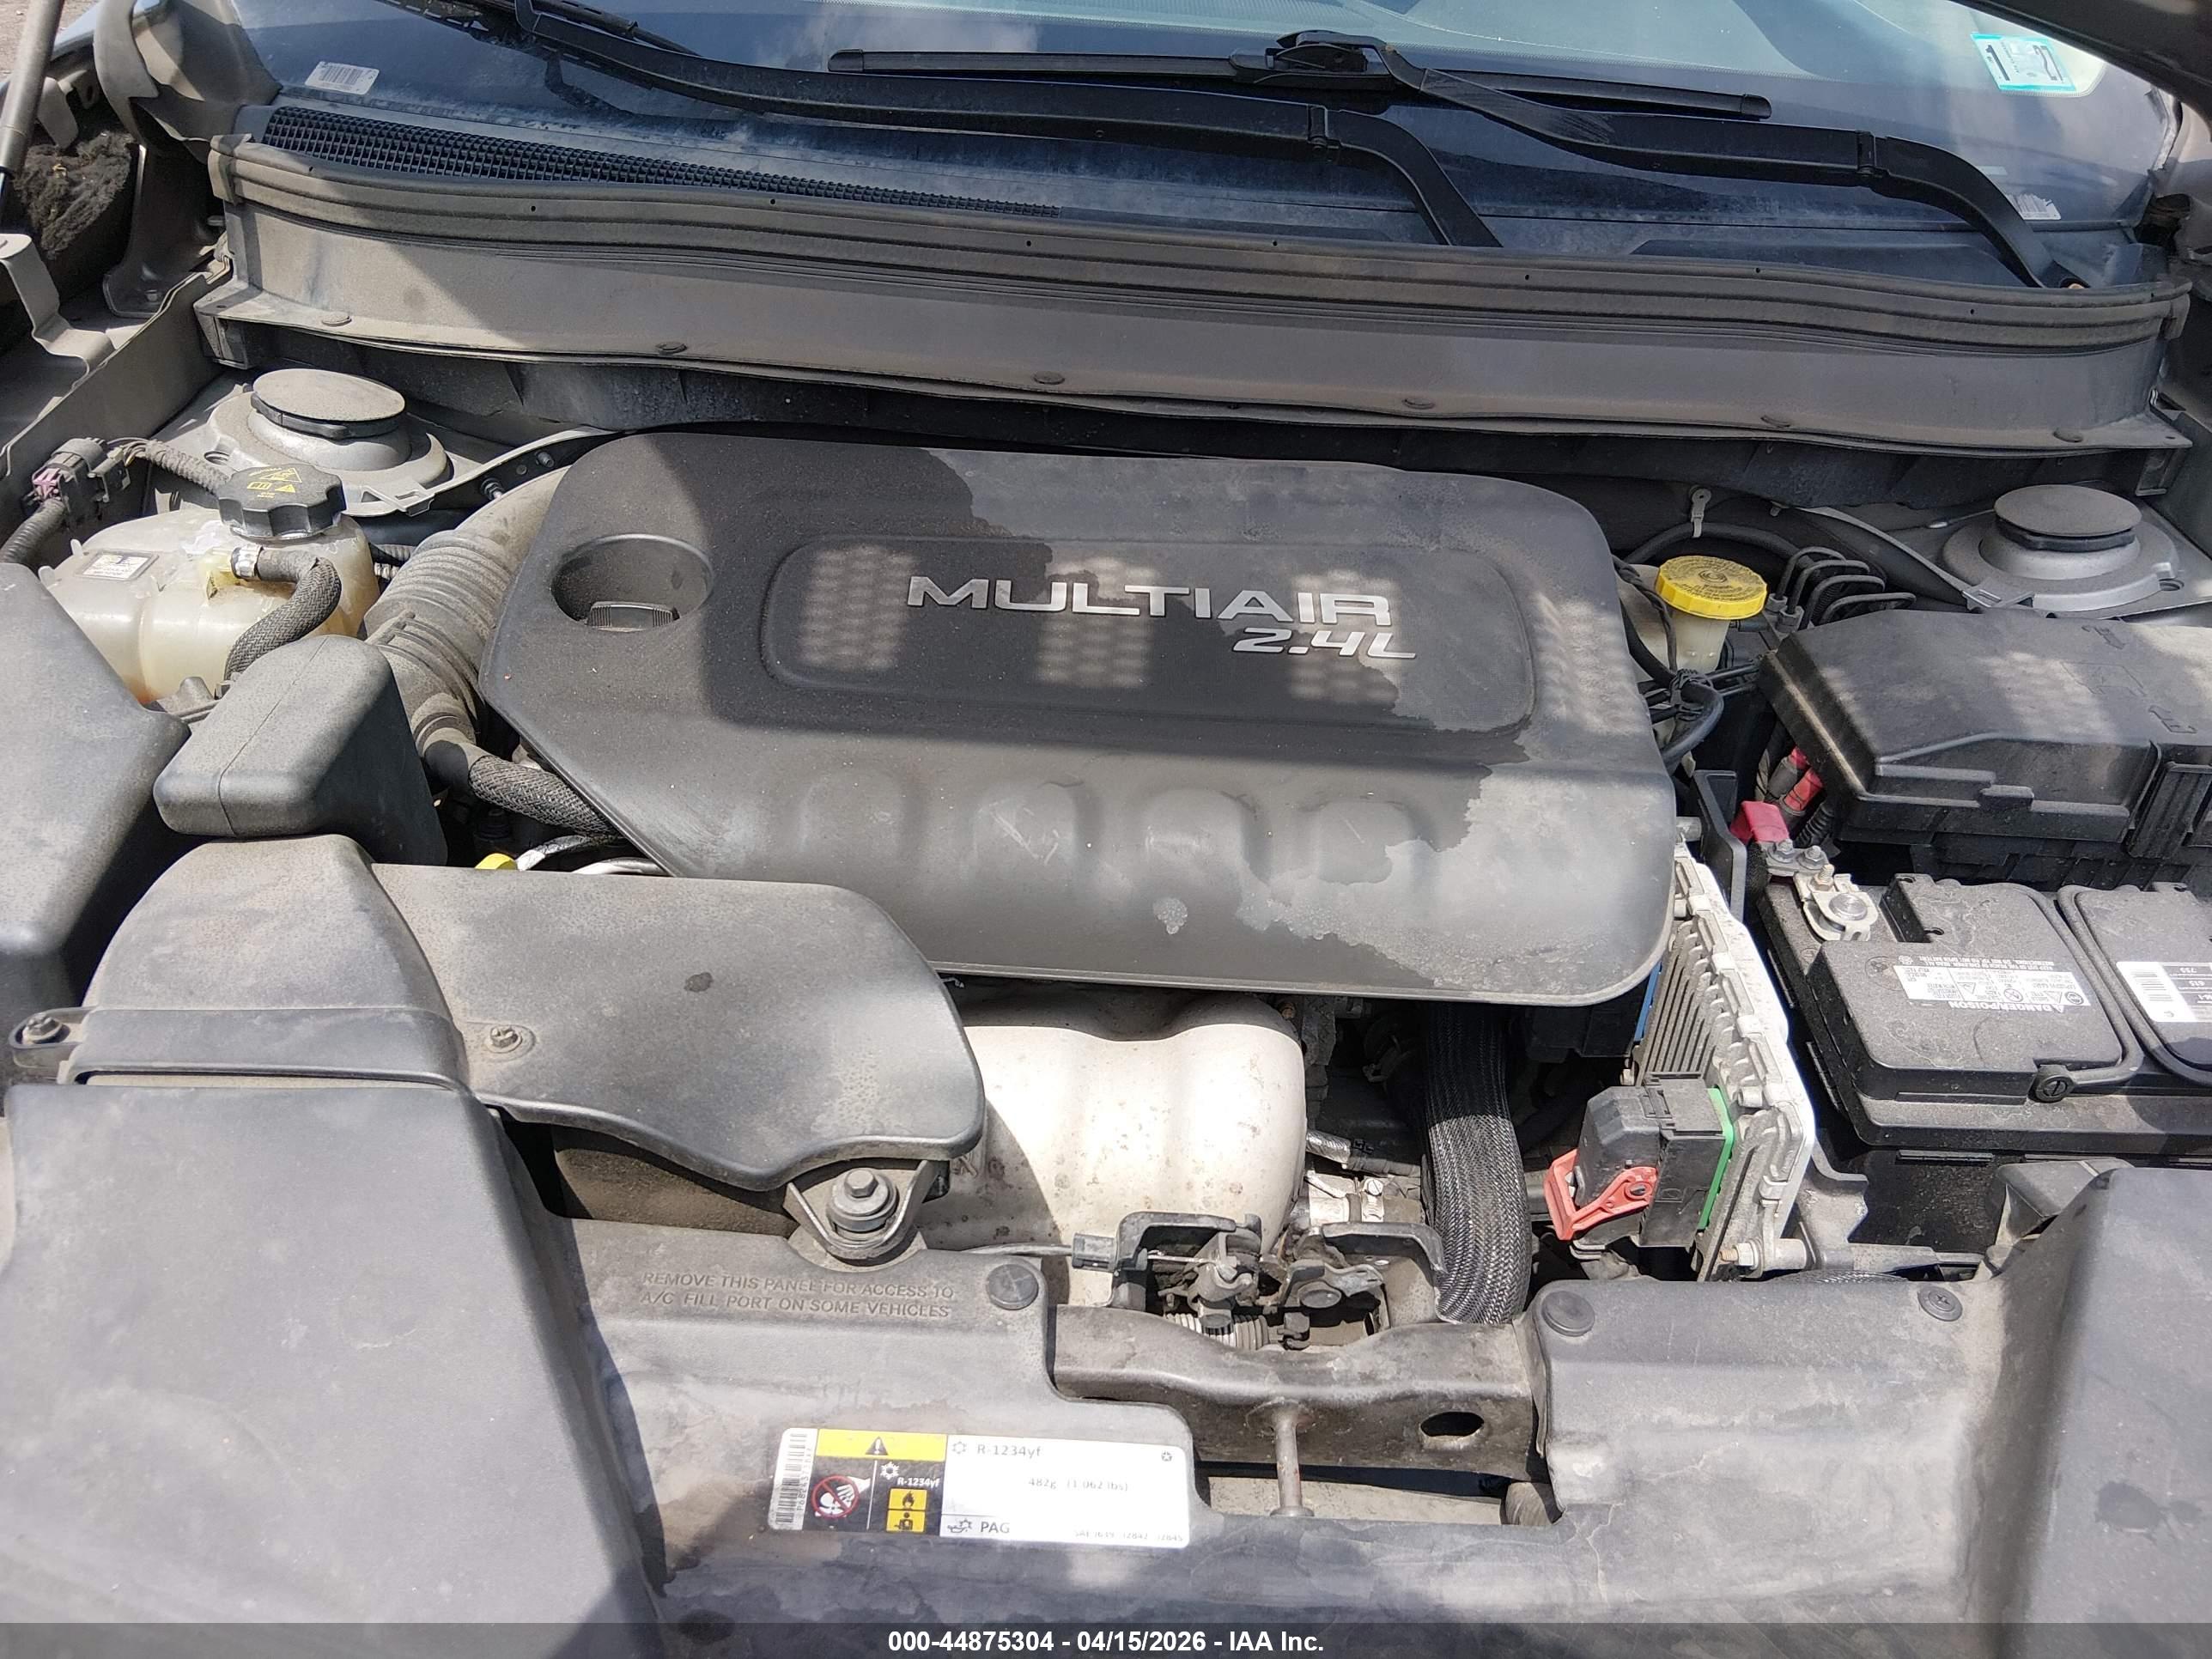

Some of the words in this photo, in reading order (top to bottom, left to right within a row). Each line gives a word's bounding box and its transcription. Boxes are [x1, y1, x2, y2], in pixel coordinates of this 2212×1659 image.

[908, 575, 1393, 626] MULTIAIR
[1232, 627, 1417, 659] 2.4L
[643, 1273, 716, 1287] REMOVE
[721, 1275, 759, 1290] THIS
[764, 1278, 817, 1292] PANEL
[822, 1280, 857, 1295] FOR
[860, 1284, 927, 1297] ACCESS
[933, 1285, 954, 1299] TO
[640, 1291, 675, 1305] A/C
[684, 1292, 718, 1306] FILL
[726, 1296, 773, 1310] PORT
[778, 1297, 805, 1311] ON
[810, 1299, 860, 1315] SOME
[866, 1302, 950, 1317] VEHICLES
[896, 1476, 940, 1489] R-1234yf
[1028, 1477, 1057, 1490] 482g
[1066, 1479, 1103, 1490] (1062
[980, 1521, 1011, 1534] PAG
